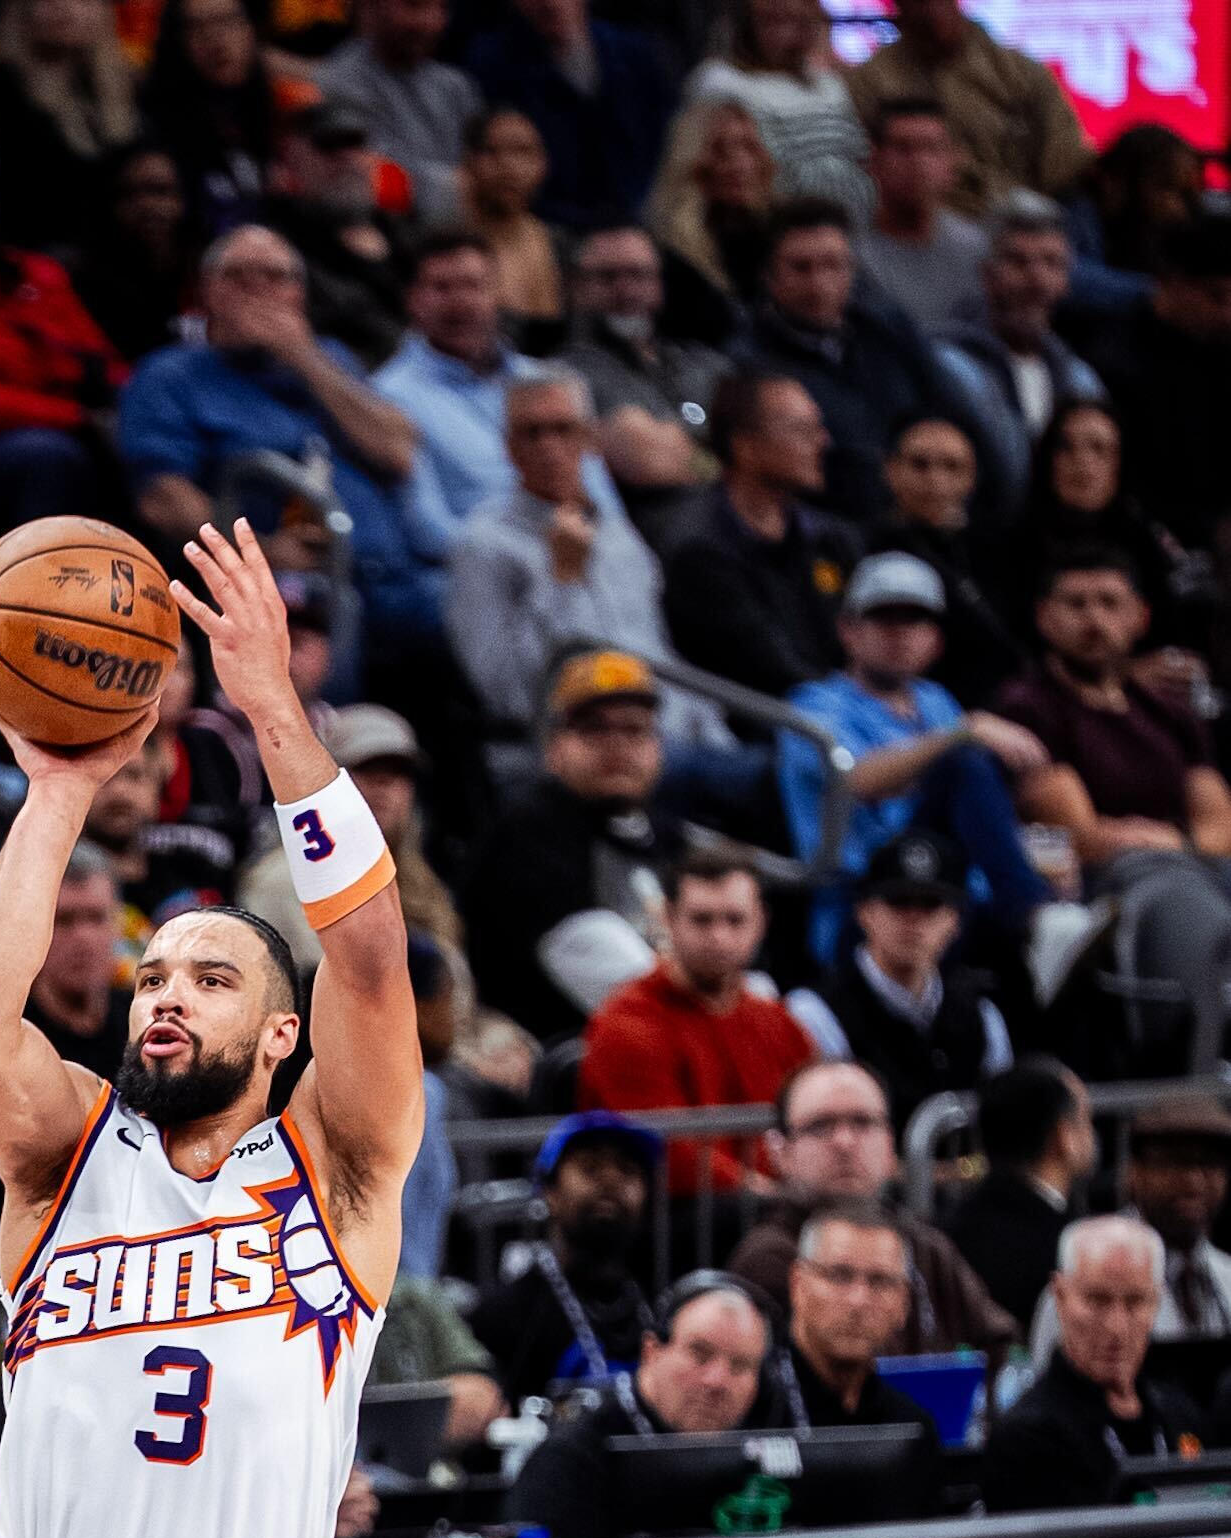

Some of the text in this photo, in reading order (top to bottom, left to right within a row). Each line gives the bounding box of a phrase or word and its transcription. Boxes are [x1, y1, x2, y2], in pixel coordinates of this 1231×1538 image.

[33, 628, 163, 696] Wilson
[292, 809, 336, 862] 3
[134, 1345, 213, 1466] 3
